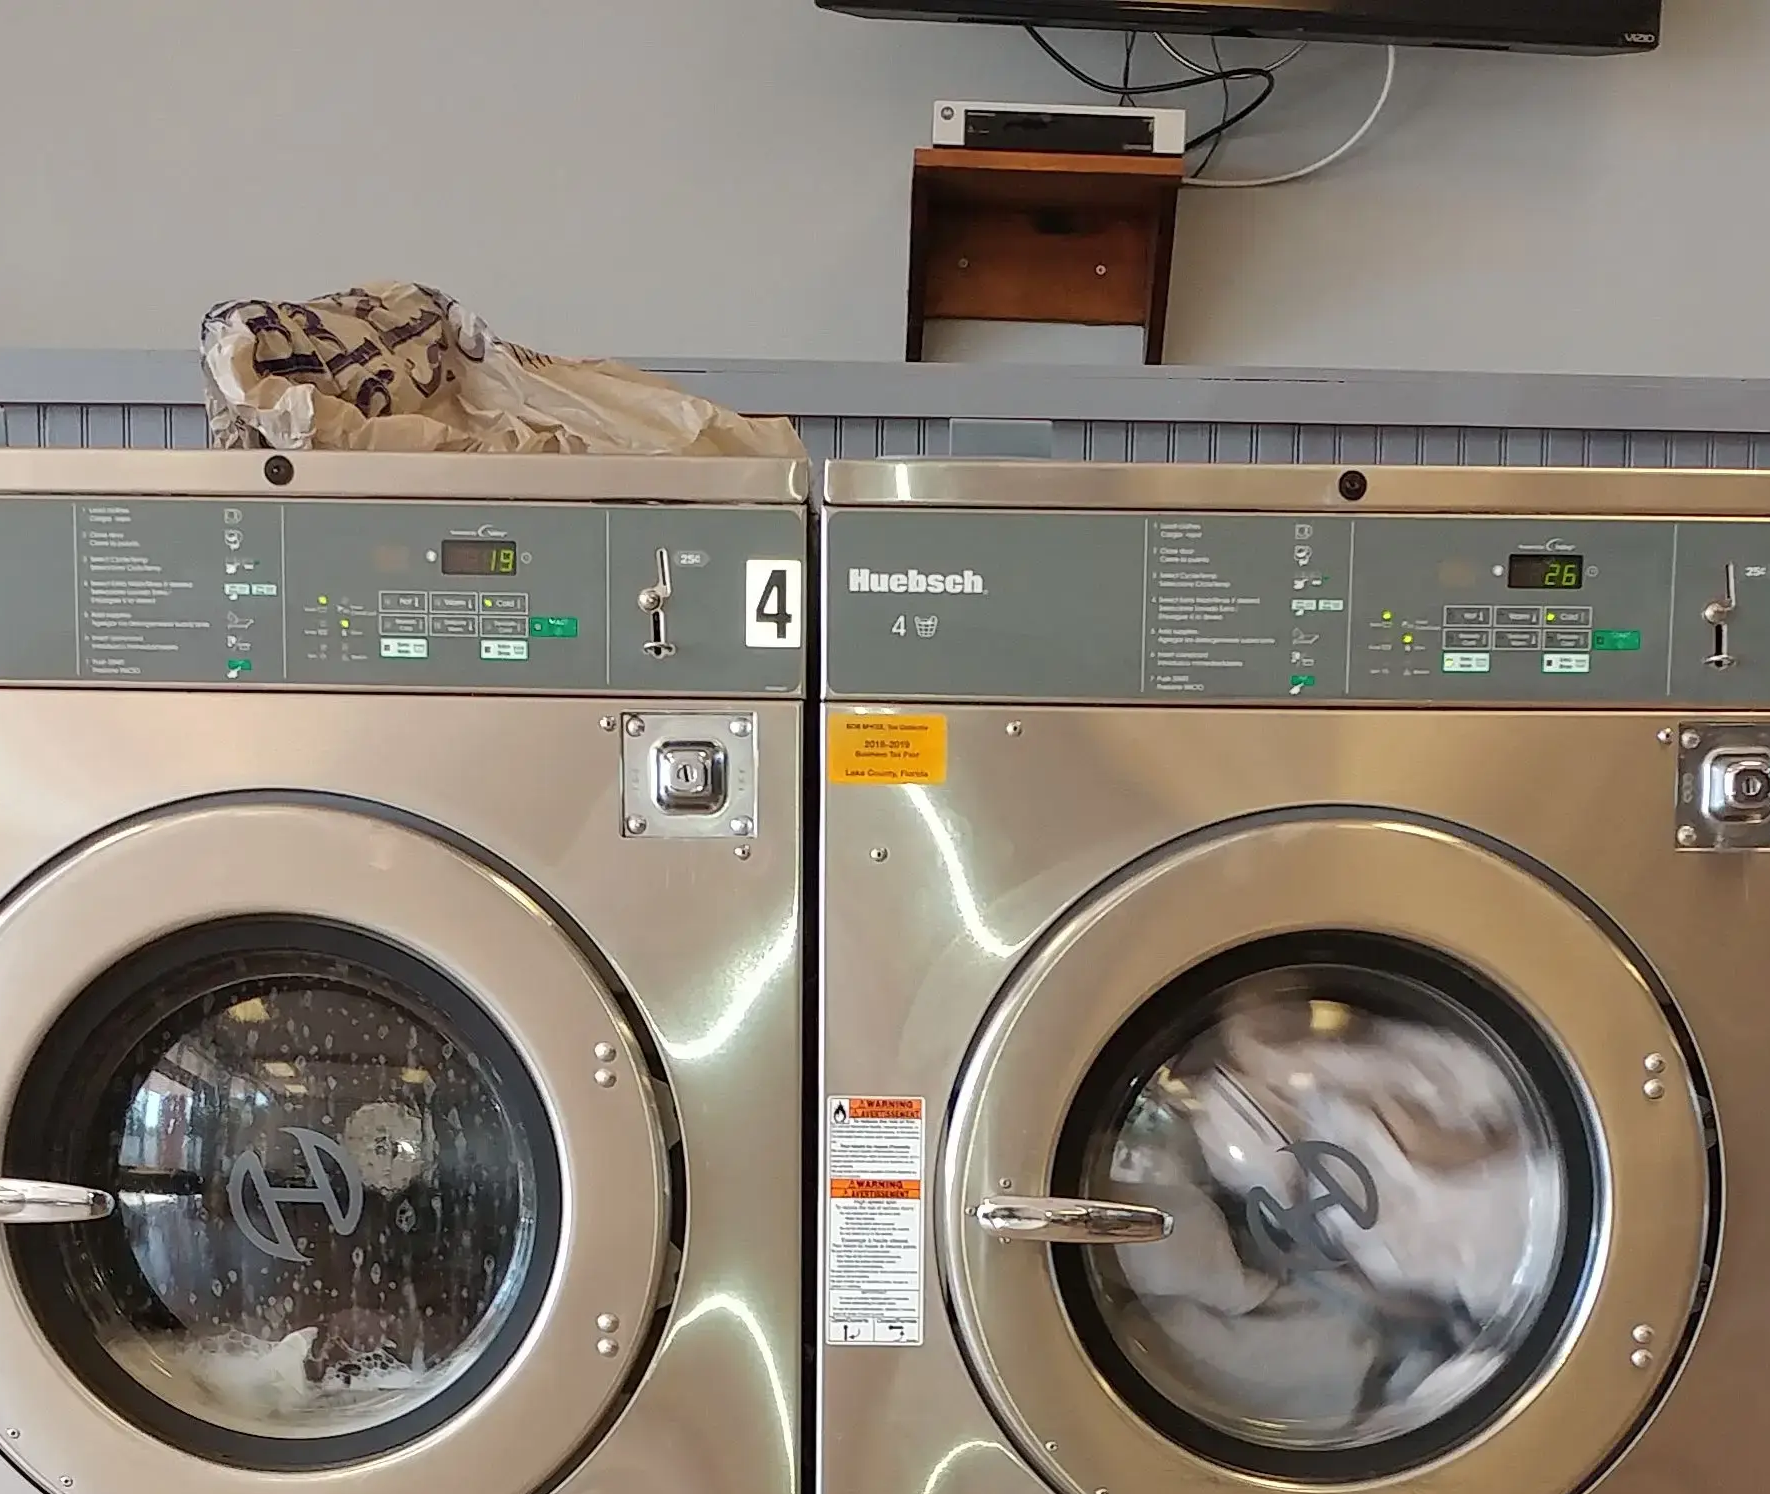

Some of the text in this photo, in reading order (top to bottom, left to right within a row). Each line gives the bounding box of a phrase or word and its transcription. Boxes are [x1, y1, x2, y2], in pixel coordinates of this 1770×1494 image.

[489, 549, 515, 573] 19
[849, 569, 983, 594] Huebsch
[1543, 563, 1578, 586] 26
[755, 569, 787, 640] 4
[891, 615, 906, 636] 4
[864, 740, 911, 749] 2018-2019
[867, 1100, 914, 1109] WARNING
[860, 1110, 921, 1119] AVERTISSEMENT
[856, 1180, 904, 1189] WARNING
[851, 1190, 910, 1198] AVERTISSEMENT
